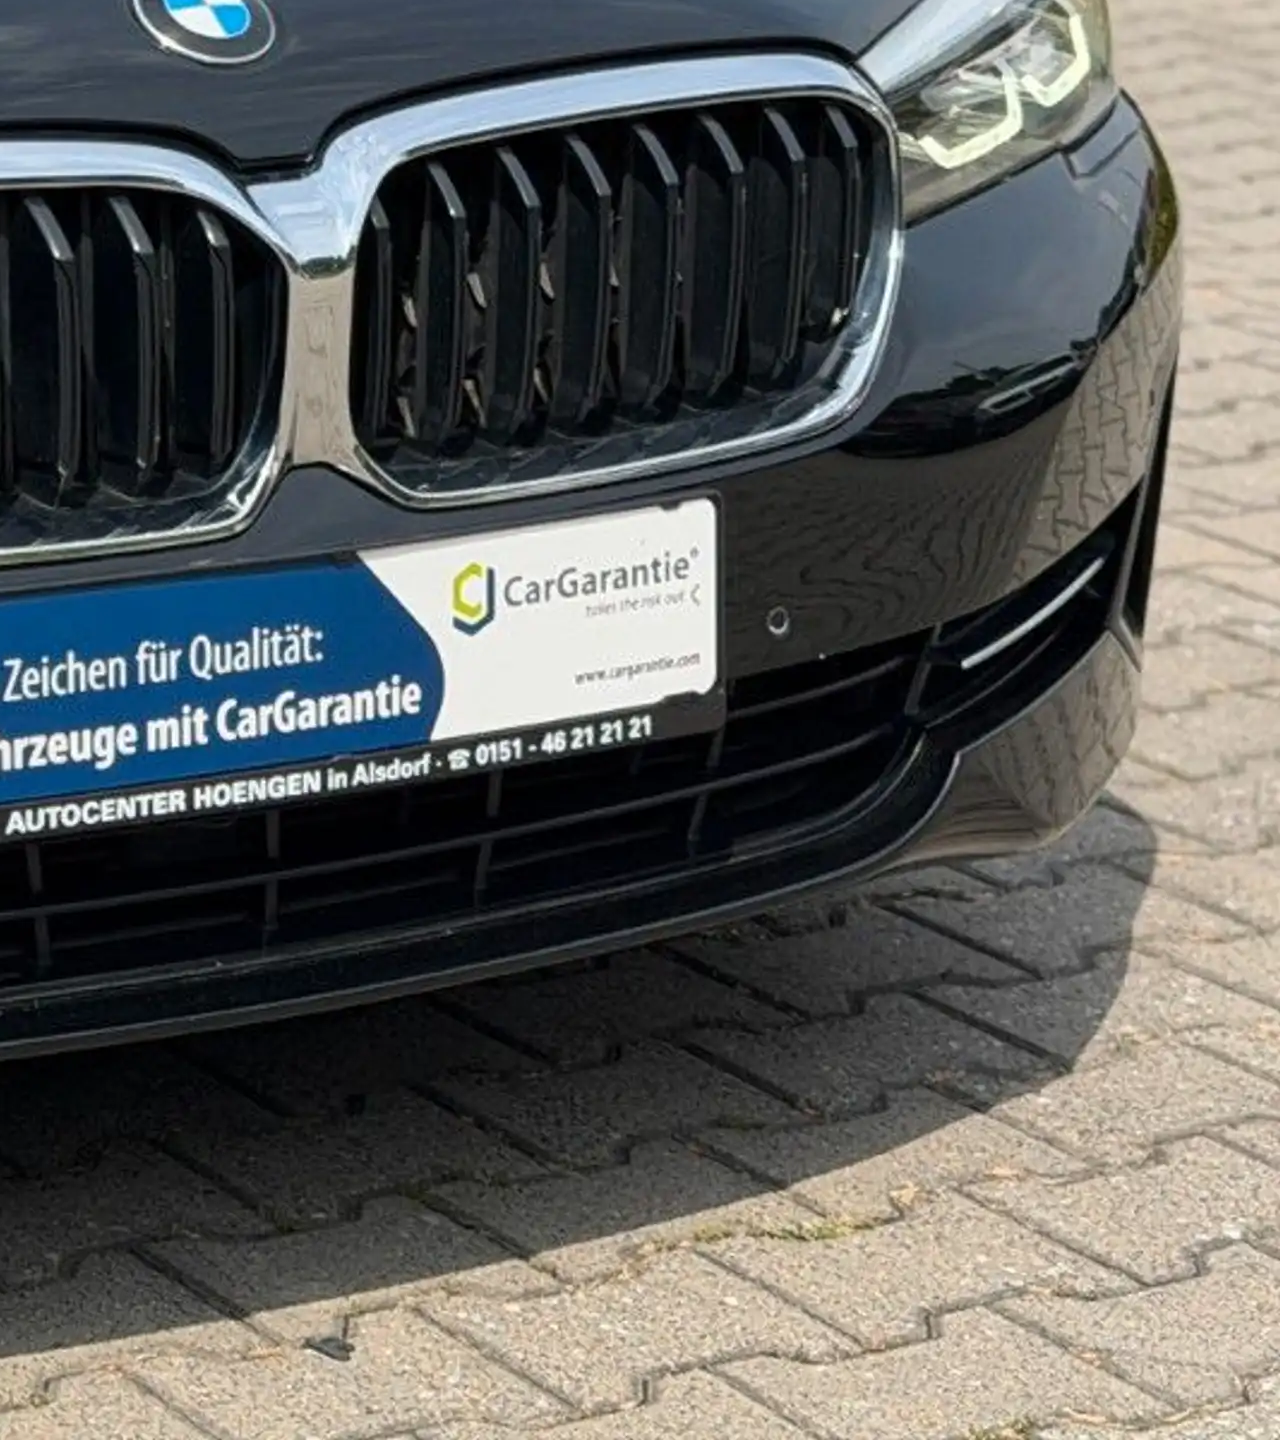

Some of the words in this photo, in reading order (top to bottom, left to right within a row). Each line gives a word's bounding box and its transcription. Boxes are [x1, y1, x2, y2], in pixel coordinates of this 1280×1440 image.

[2, 648, 127, 703] Zeichen
[135, 639, 182, 686] für
[189, 624, 324, 680] Qualität:
[146, 704, 209, 752] mit
[216, 674, 423, 741] CarGarantie
[4, 788, 187, 836] AUTOCENTER
[193, 769, 321, 810] HOENGEN
[327, 767, 348, 790] in
[351, 753, 432, 786] Alsdorf
[474, 737, 524, 766] 0151
[541, 730, 567, 754] 46
[570, 724, 595, 750] 21
[600, 719, 624, 745] 21
[628, 715, 654, 740] 21
